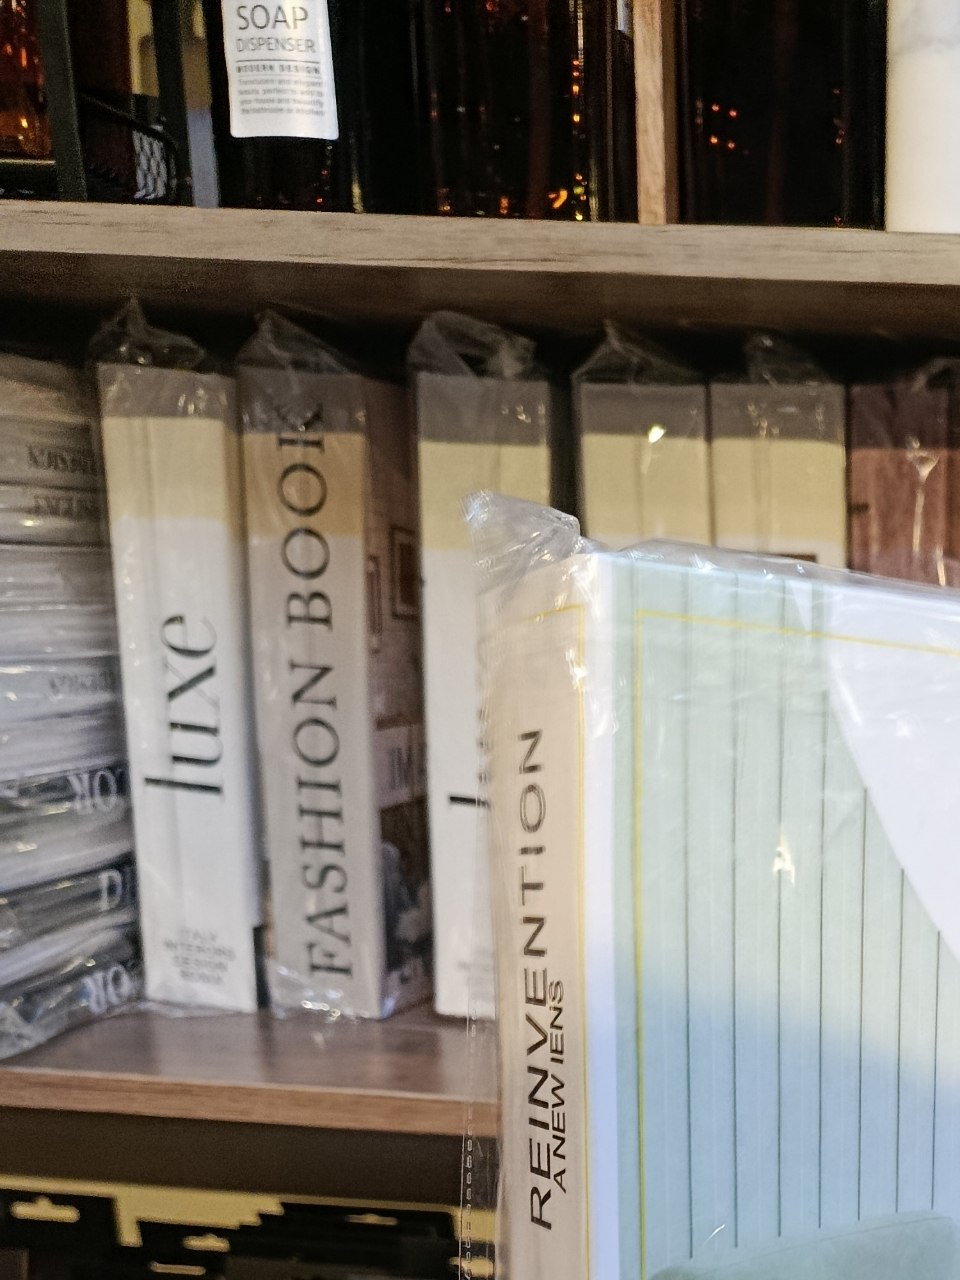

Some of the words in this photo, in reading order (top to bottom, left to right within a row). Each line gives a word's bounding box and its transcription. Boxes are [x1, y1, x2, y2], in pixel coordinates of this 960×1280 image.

[235, 4, 309, 31] SOAP
[235, 37, 317, 54] DISPENSER
[276, 402, 334, 633] BOOK
[143, 614, 225, 802] luxe
[288, 658, 352, 983] FASHION
[518, 728, 552, 1231] REINVENTION
[549, 979, 565, 1064] IENS
[550, 1073, 566, 1161] NEW
[553, 1167, 567, 1194] A
